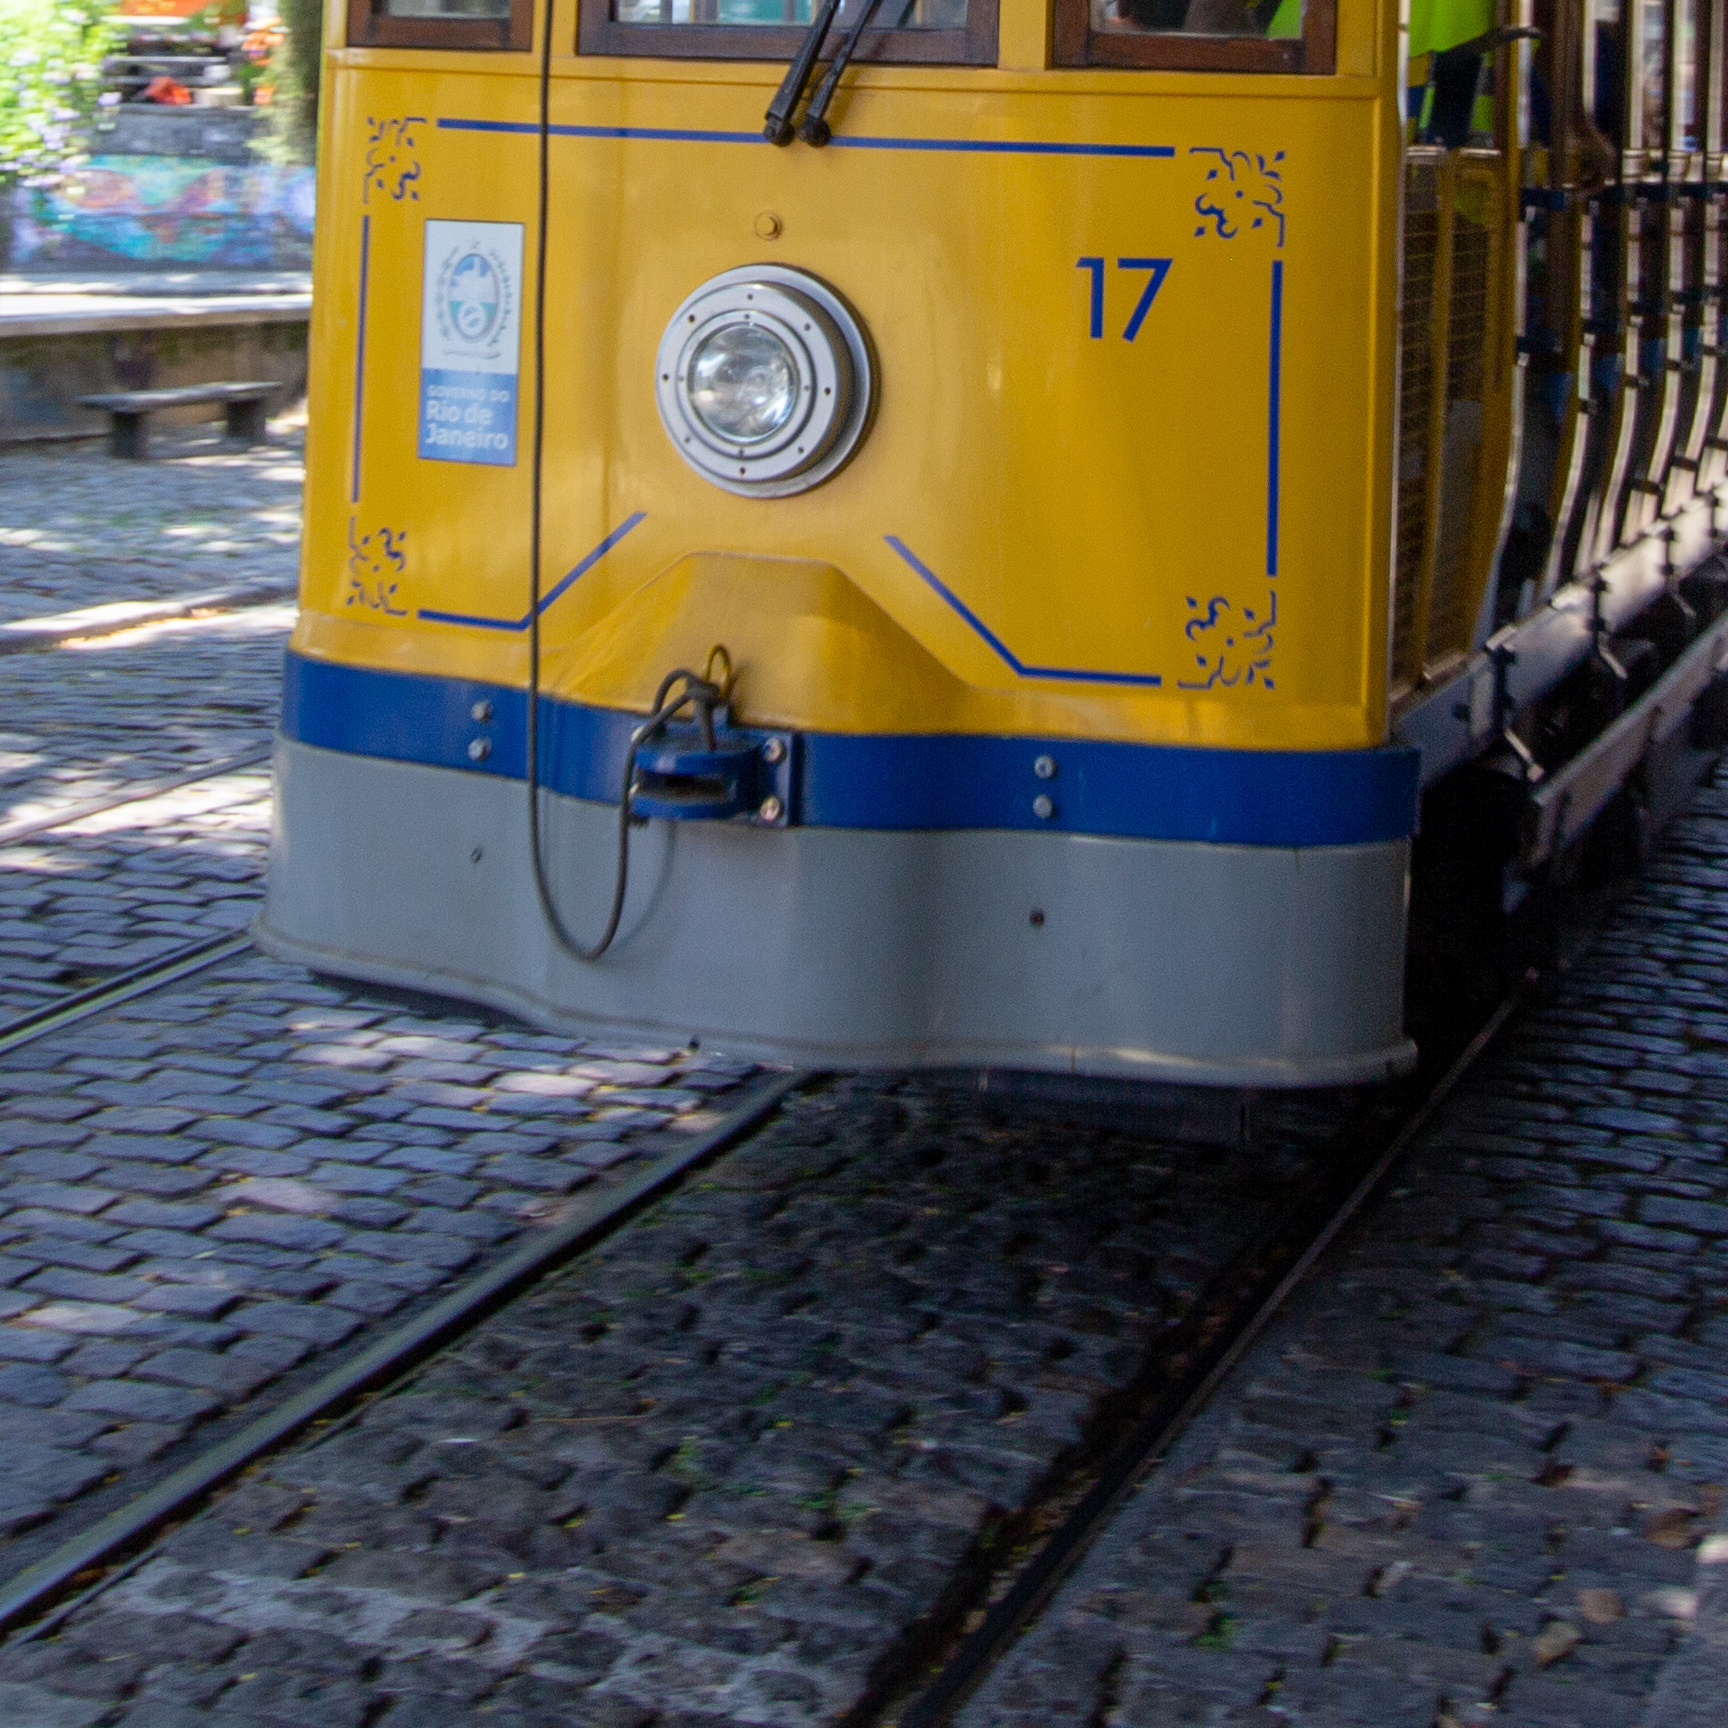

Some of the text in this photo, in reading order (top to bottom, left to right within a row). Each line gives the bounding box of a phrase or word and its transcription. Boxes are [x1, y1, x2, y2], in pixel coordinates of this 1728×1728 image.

[1075, 256, 1174, 342] 17
[489, 389, 511, 403] DO
[426, 399, 494, 426] Rio de
[425, 423, 510, 450] Janeiro
